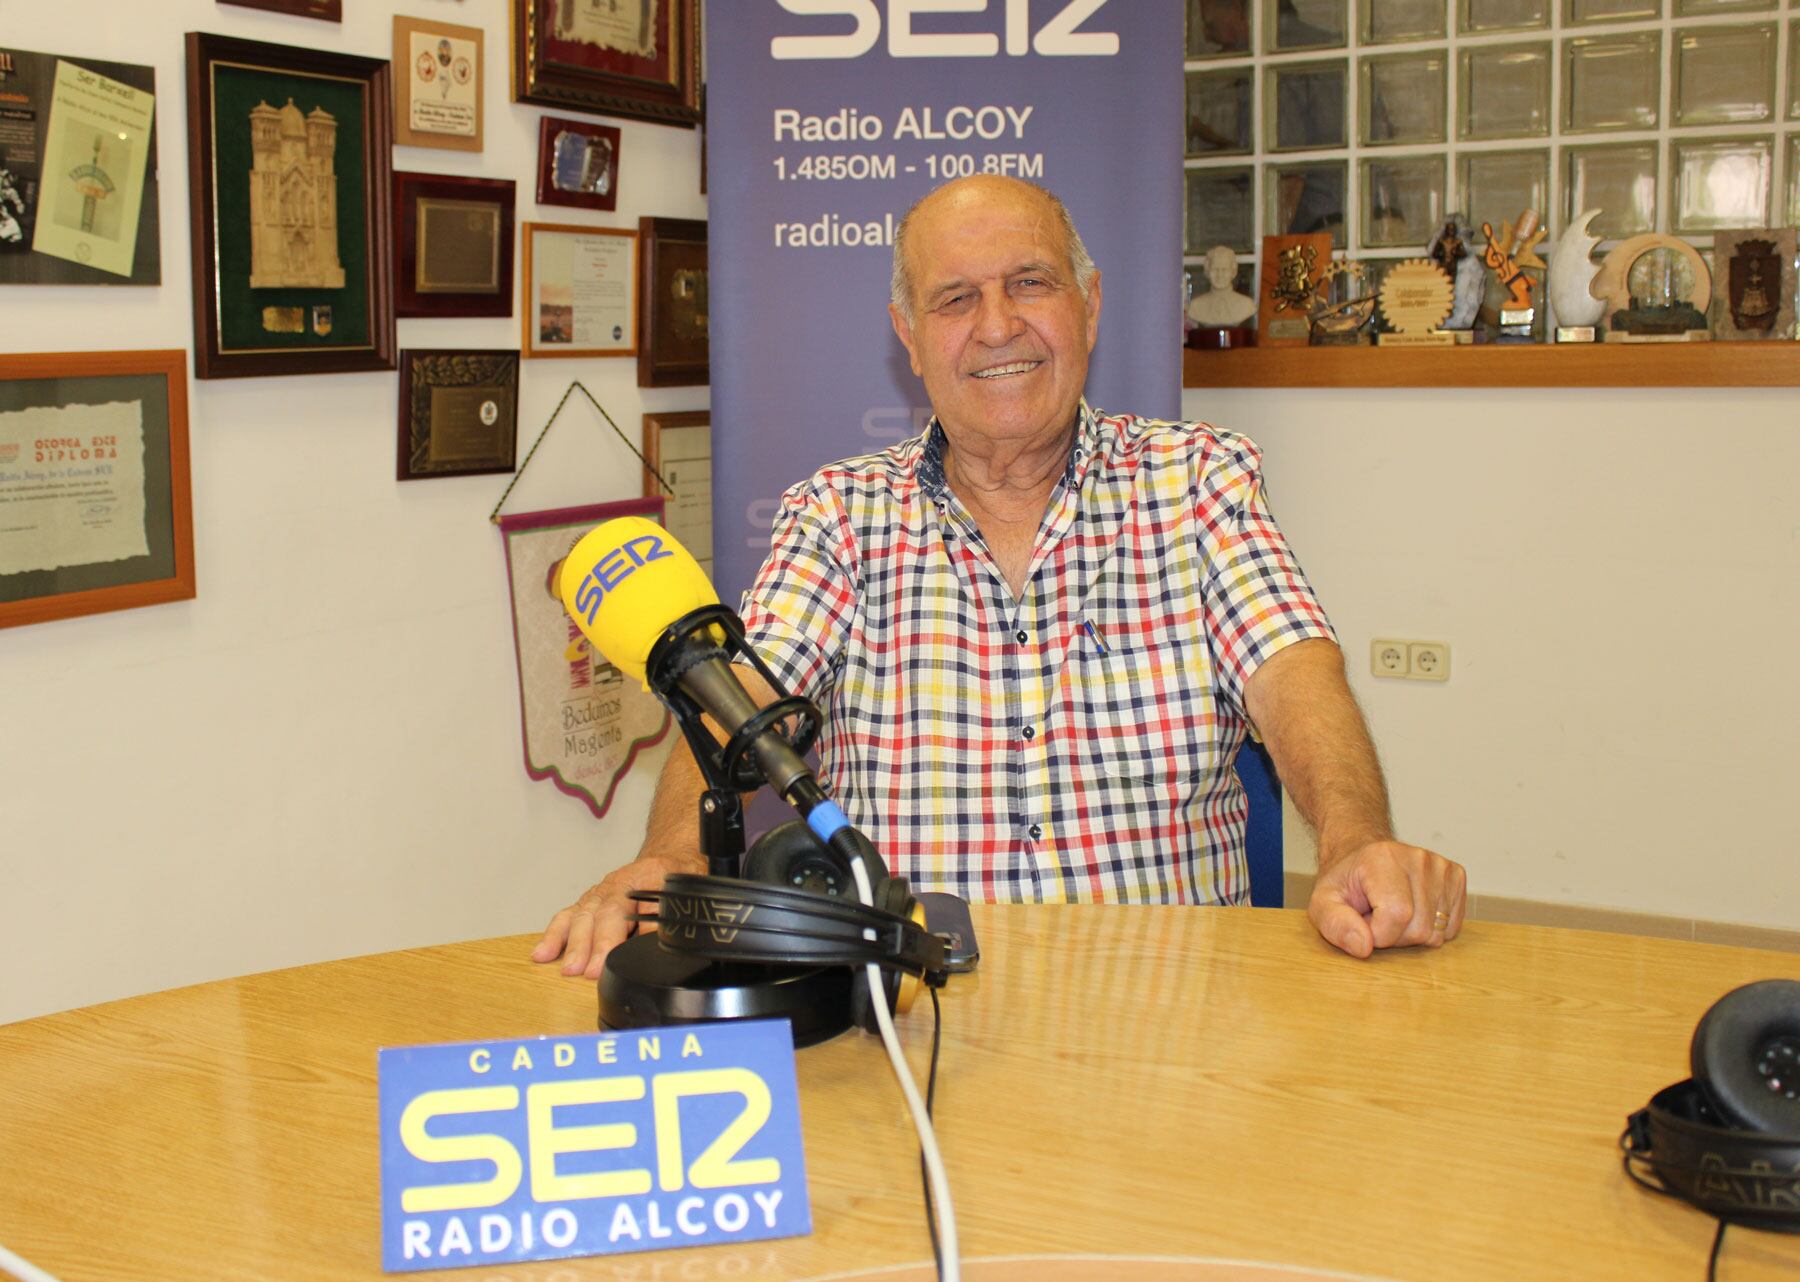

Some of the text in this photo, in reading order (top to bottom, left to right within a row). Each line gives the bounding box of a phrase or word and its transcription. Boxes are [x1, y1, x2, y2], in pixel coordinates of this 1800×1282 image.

[773, 106, 1034, 142] Radio ALCOY
[774, 213, 900, 248] radioal
[575, 535, 675, 627] SER
[468, 1033, 704, 1074] CADENA
[399, 1067, 782, 1214] SER
[402, 1189, 784, 1260] RADIO ALCOY
